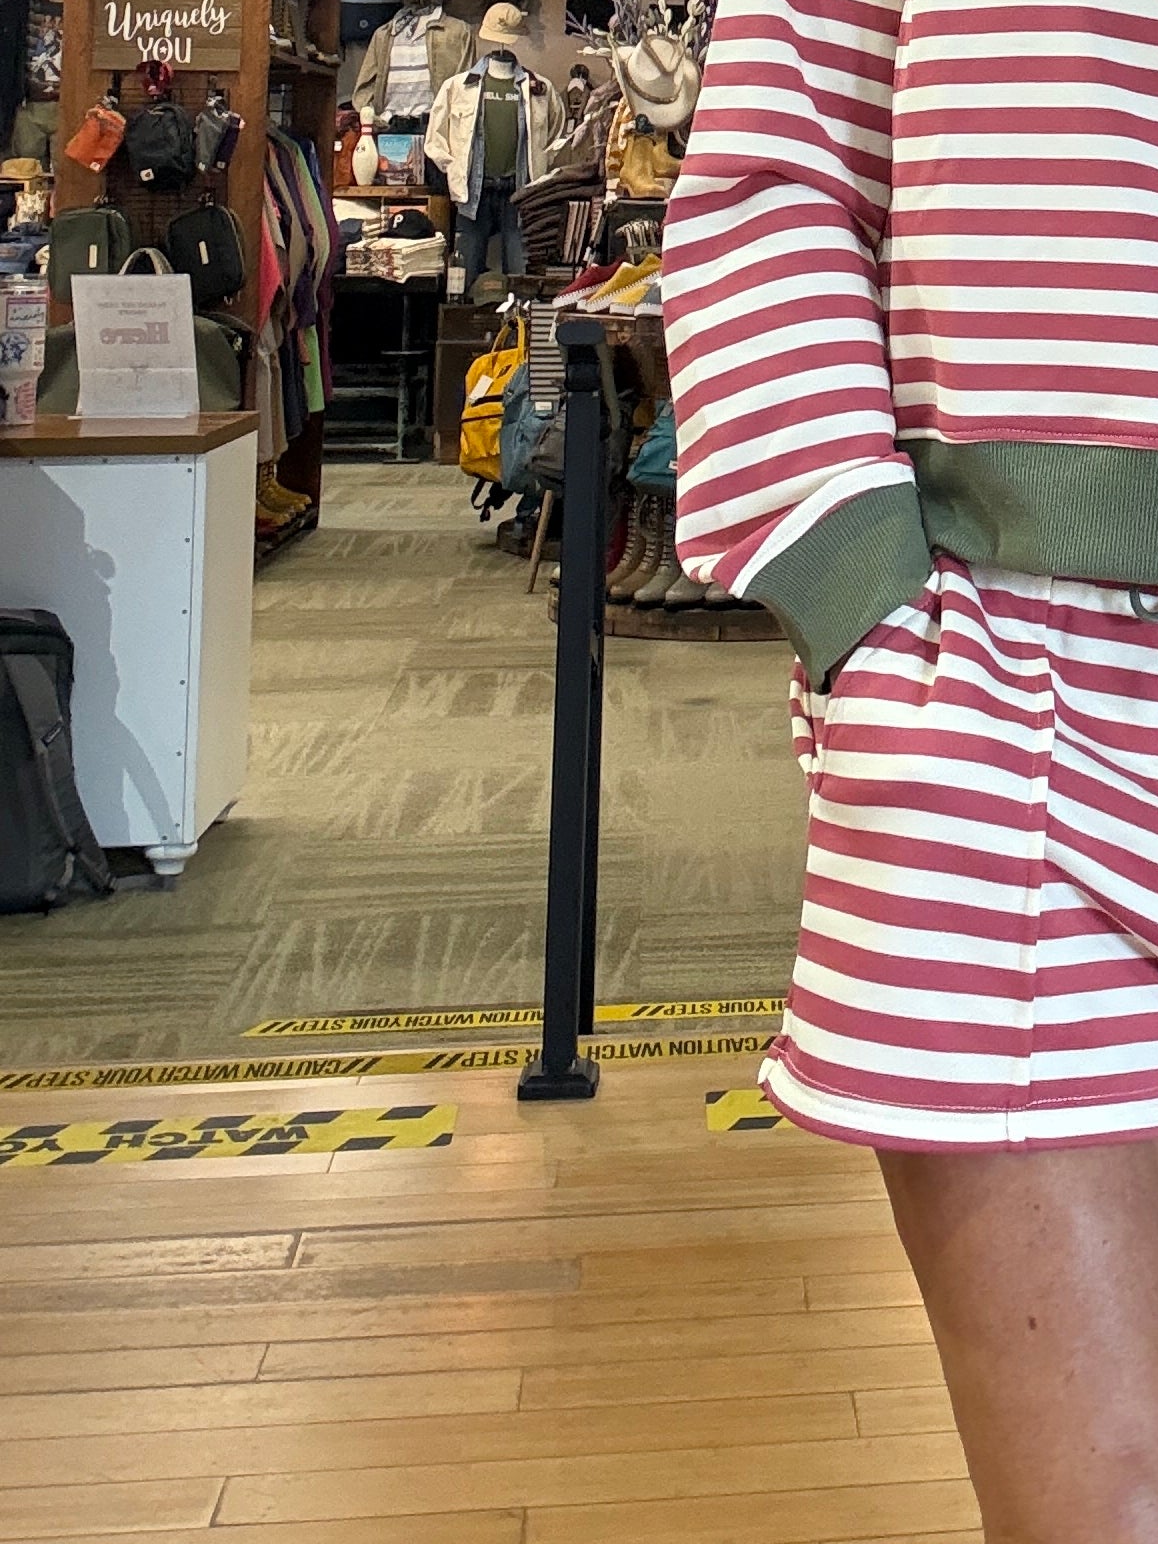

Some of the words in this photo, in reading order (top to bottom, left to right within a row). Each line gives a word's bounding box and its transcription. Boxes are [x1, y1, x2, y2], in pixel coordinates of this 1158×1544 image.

[137, 37, 191, 63] YOU
[664, 1001, 713, 1016] STEP
[718, 1000, 769, 1014] YOUR
[292, 1019, 346, 1033] STEP
[350, 1016, 401, 1030] YOUR
[404, 1013, 474, 1028] WATCH
[479, 1010, 544, 1024] AUTION
[587, 1042, 664, 1061] WATCH
[669, 1037, 759, 1056] CAUTION
[461, 1049, 519, 1068] STEP
[92, 1067, 154, 1085] YOUR
[158, 1063, 240, 1083] WATCH
[243, 1059, 342, 1079] CAUTION
[26, 1070, 91, 1088] STEP
[105, 1125, 310, 1148] WATCH
